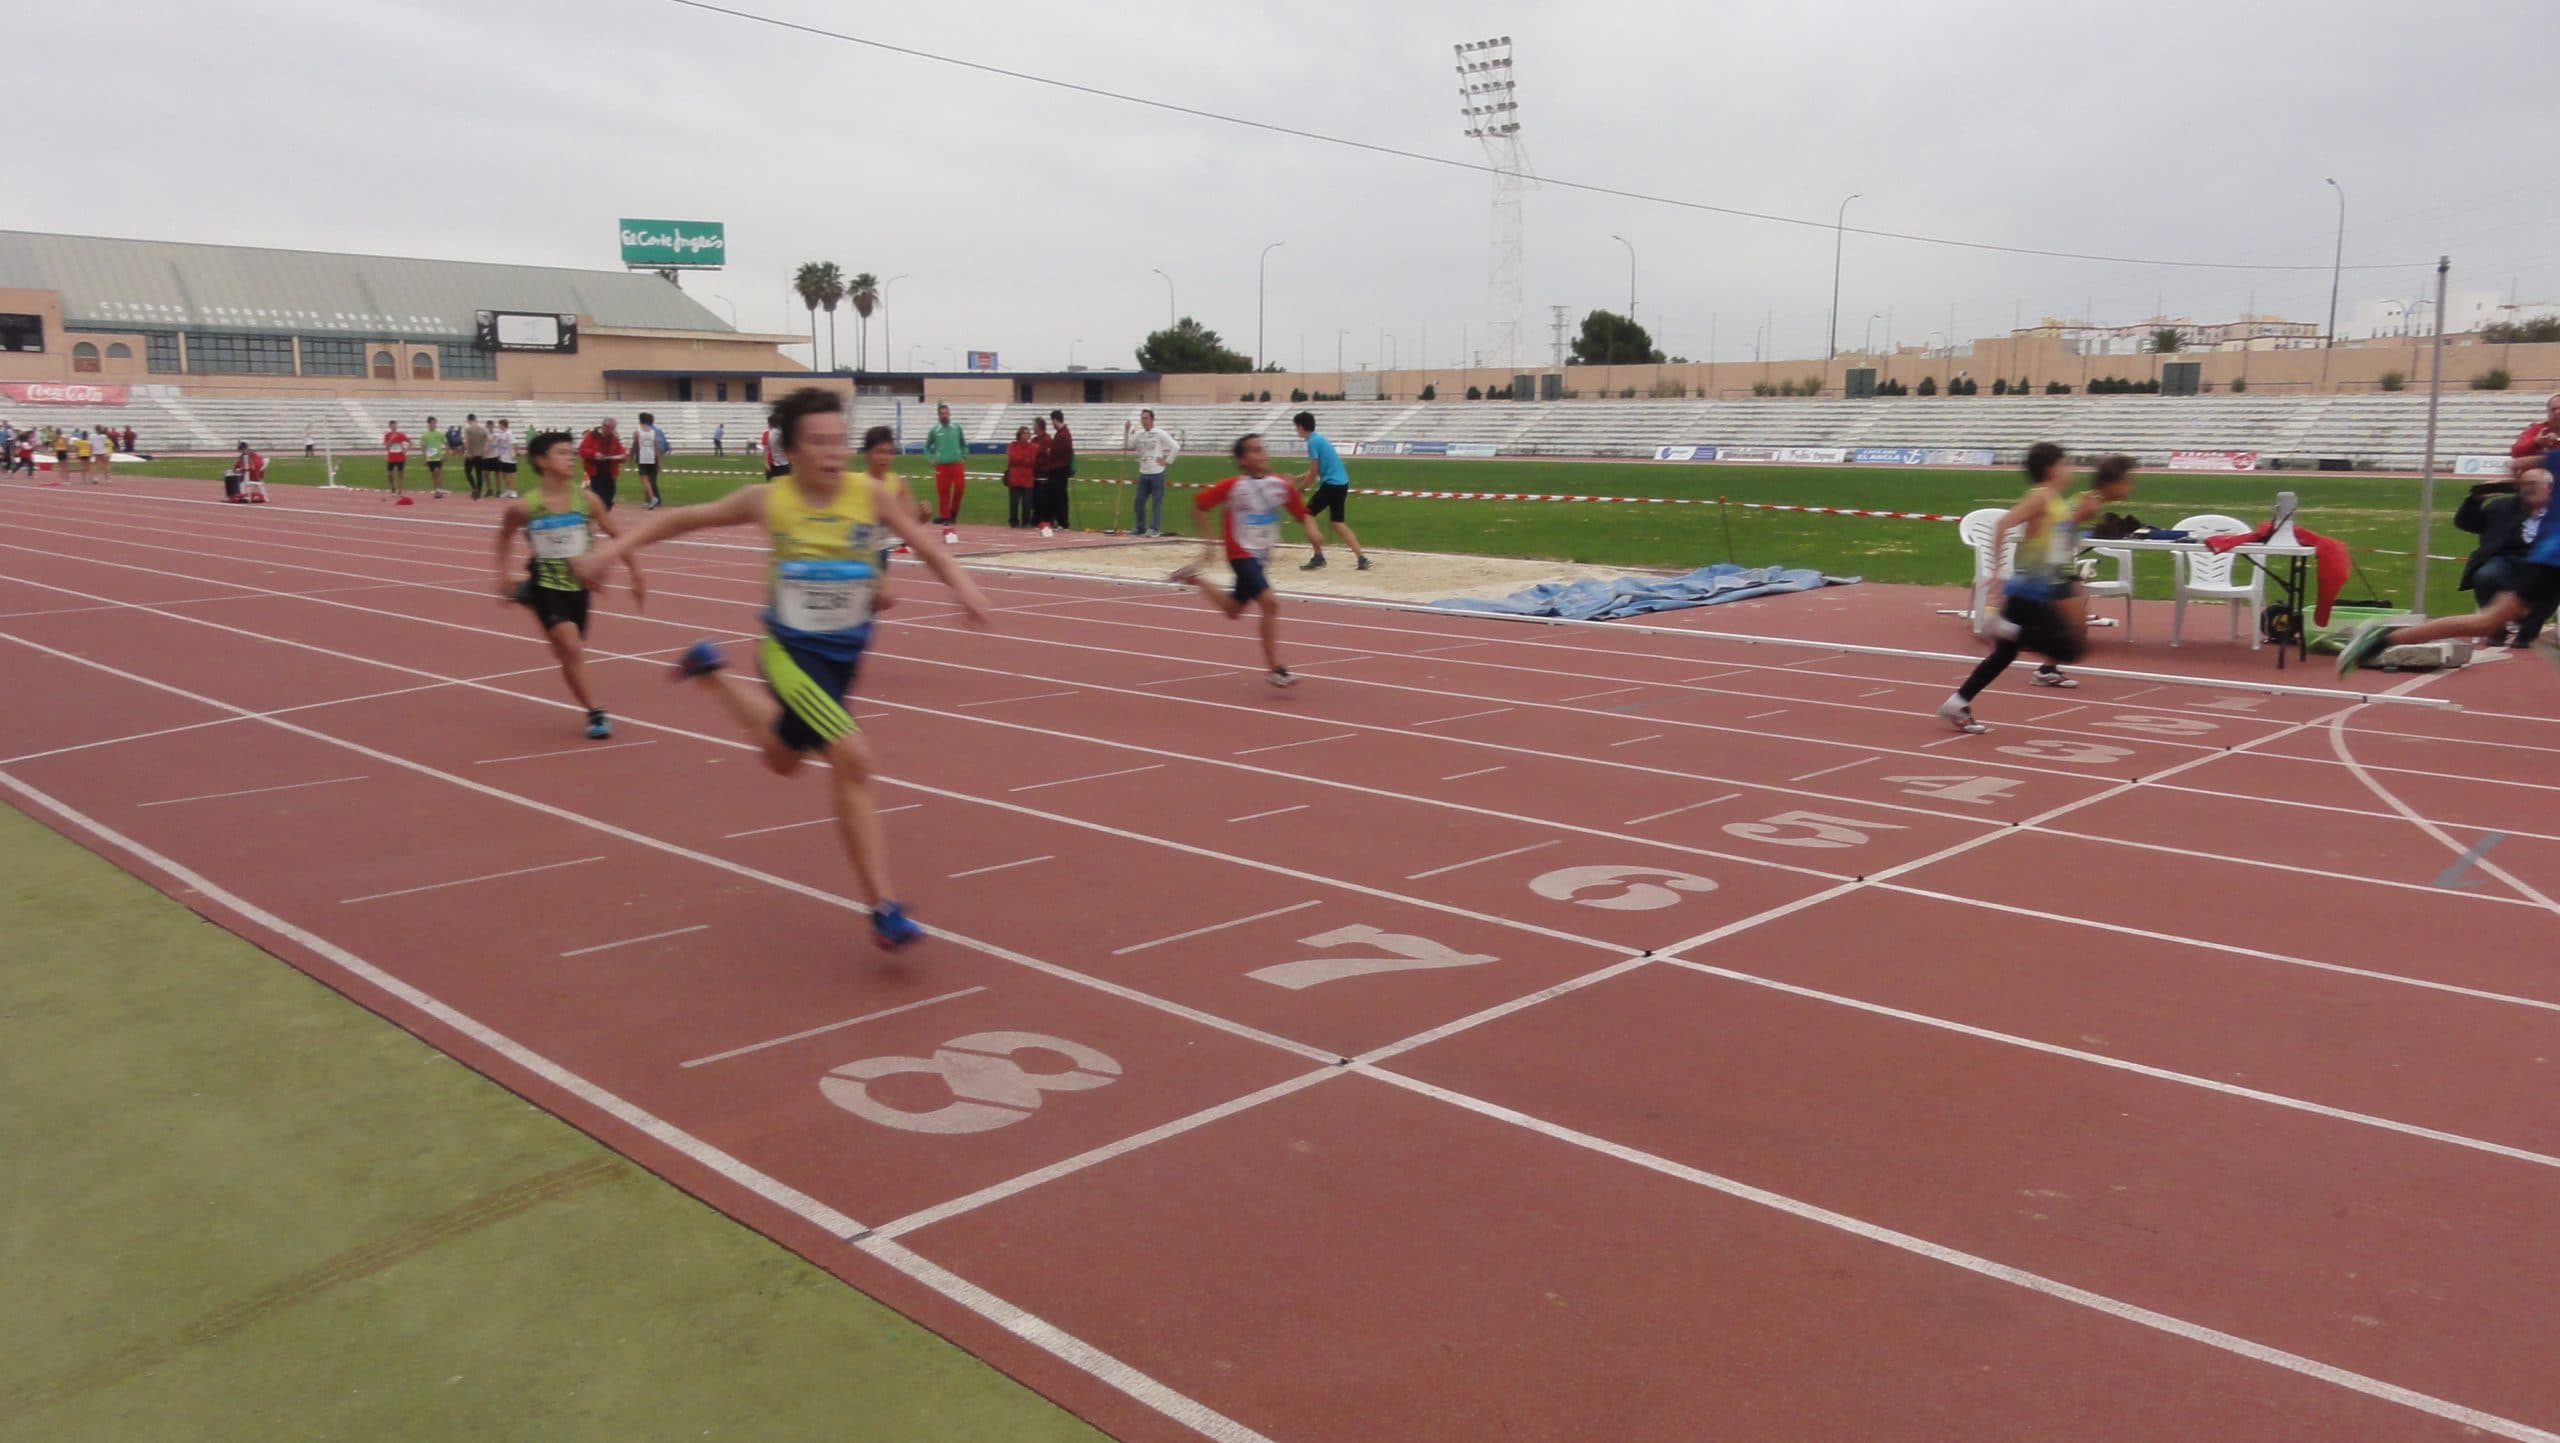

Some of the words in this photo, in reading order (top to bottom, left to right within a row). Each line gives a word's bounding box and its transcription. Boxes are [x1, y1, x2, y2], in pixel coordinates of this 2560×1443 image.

[621, 230, 637, 246] El
[638, 231, 673, 247] Corte
[673, 228, 723, 253] Inglés
[2088, 715, 2220, 736] 2
[1995, 739, 2136, 763] 3
[1880, 776, 2027, 804] 4
[1721, 810, 1911, 848] 5
[1528, 865, 1720, 911] 6
[1245, 923, 1501, 990] 7
[819, 1030, 1124, 1135] 8
